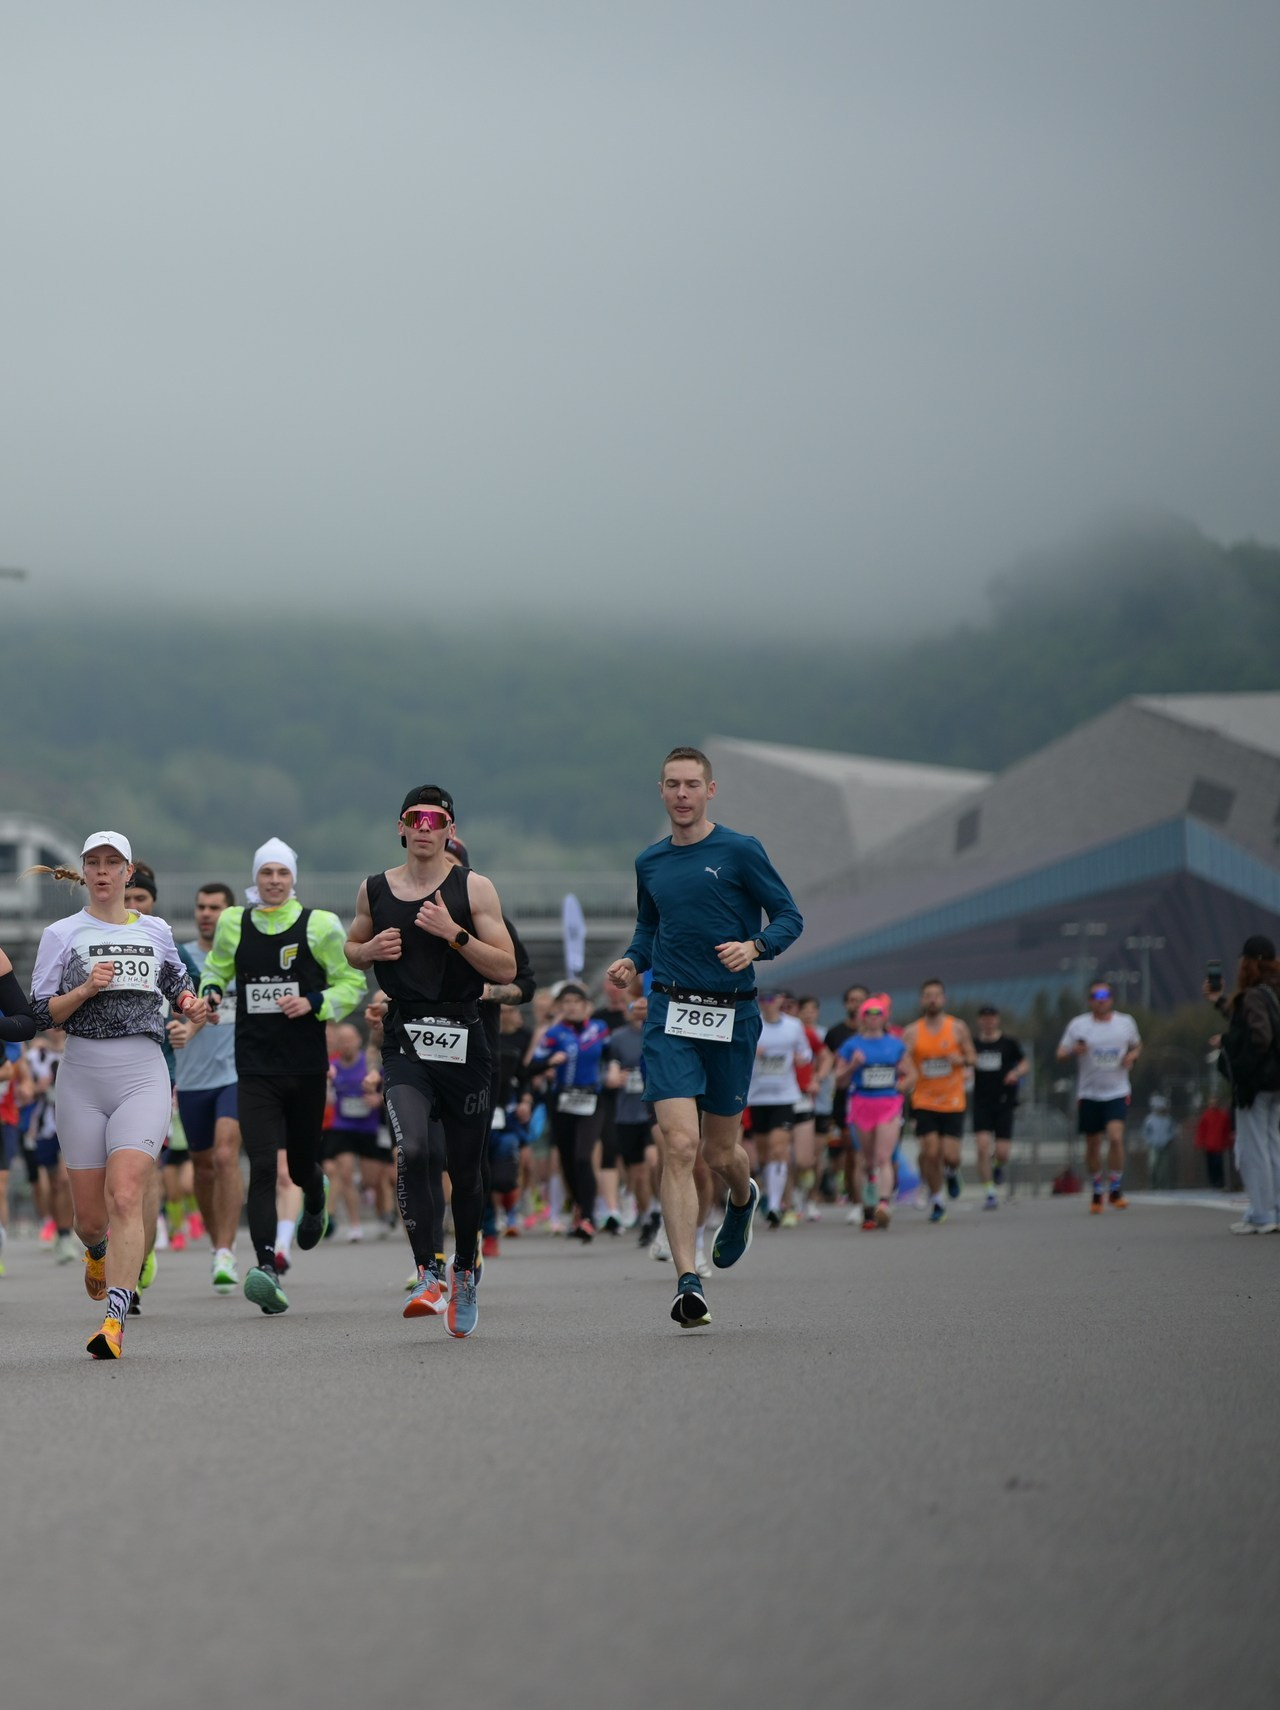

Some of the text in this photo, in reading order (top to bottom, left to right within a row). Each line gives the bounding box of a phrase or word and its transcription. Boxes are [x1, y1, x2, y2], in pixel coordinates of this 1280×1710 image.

[98, 960, 150, 977] 830
[676, 1008, 728, 1028] 7867
[410, 1029, 461, 1049] 7847
[386, 1099, 404, 1142] VENUM
[397, 1175, 409, 1216] VENUM
